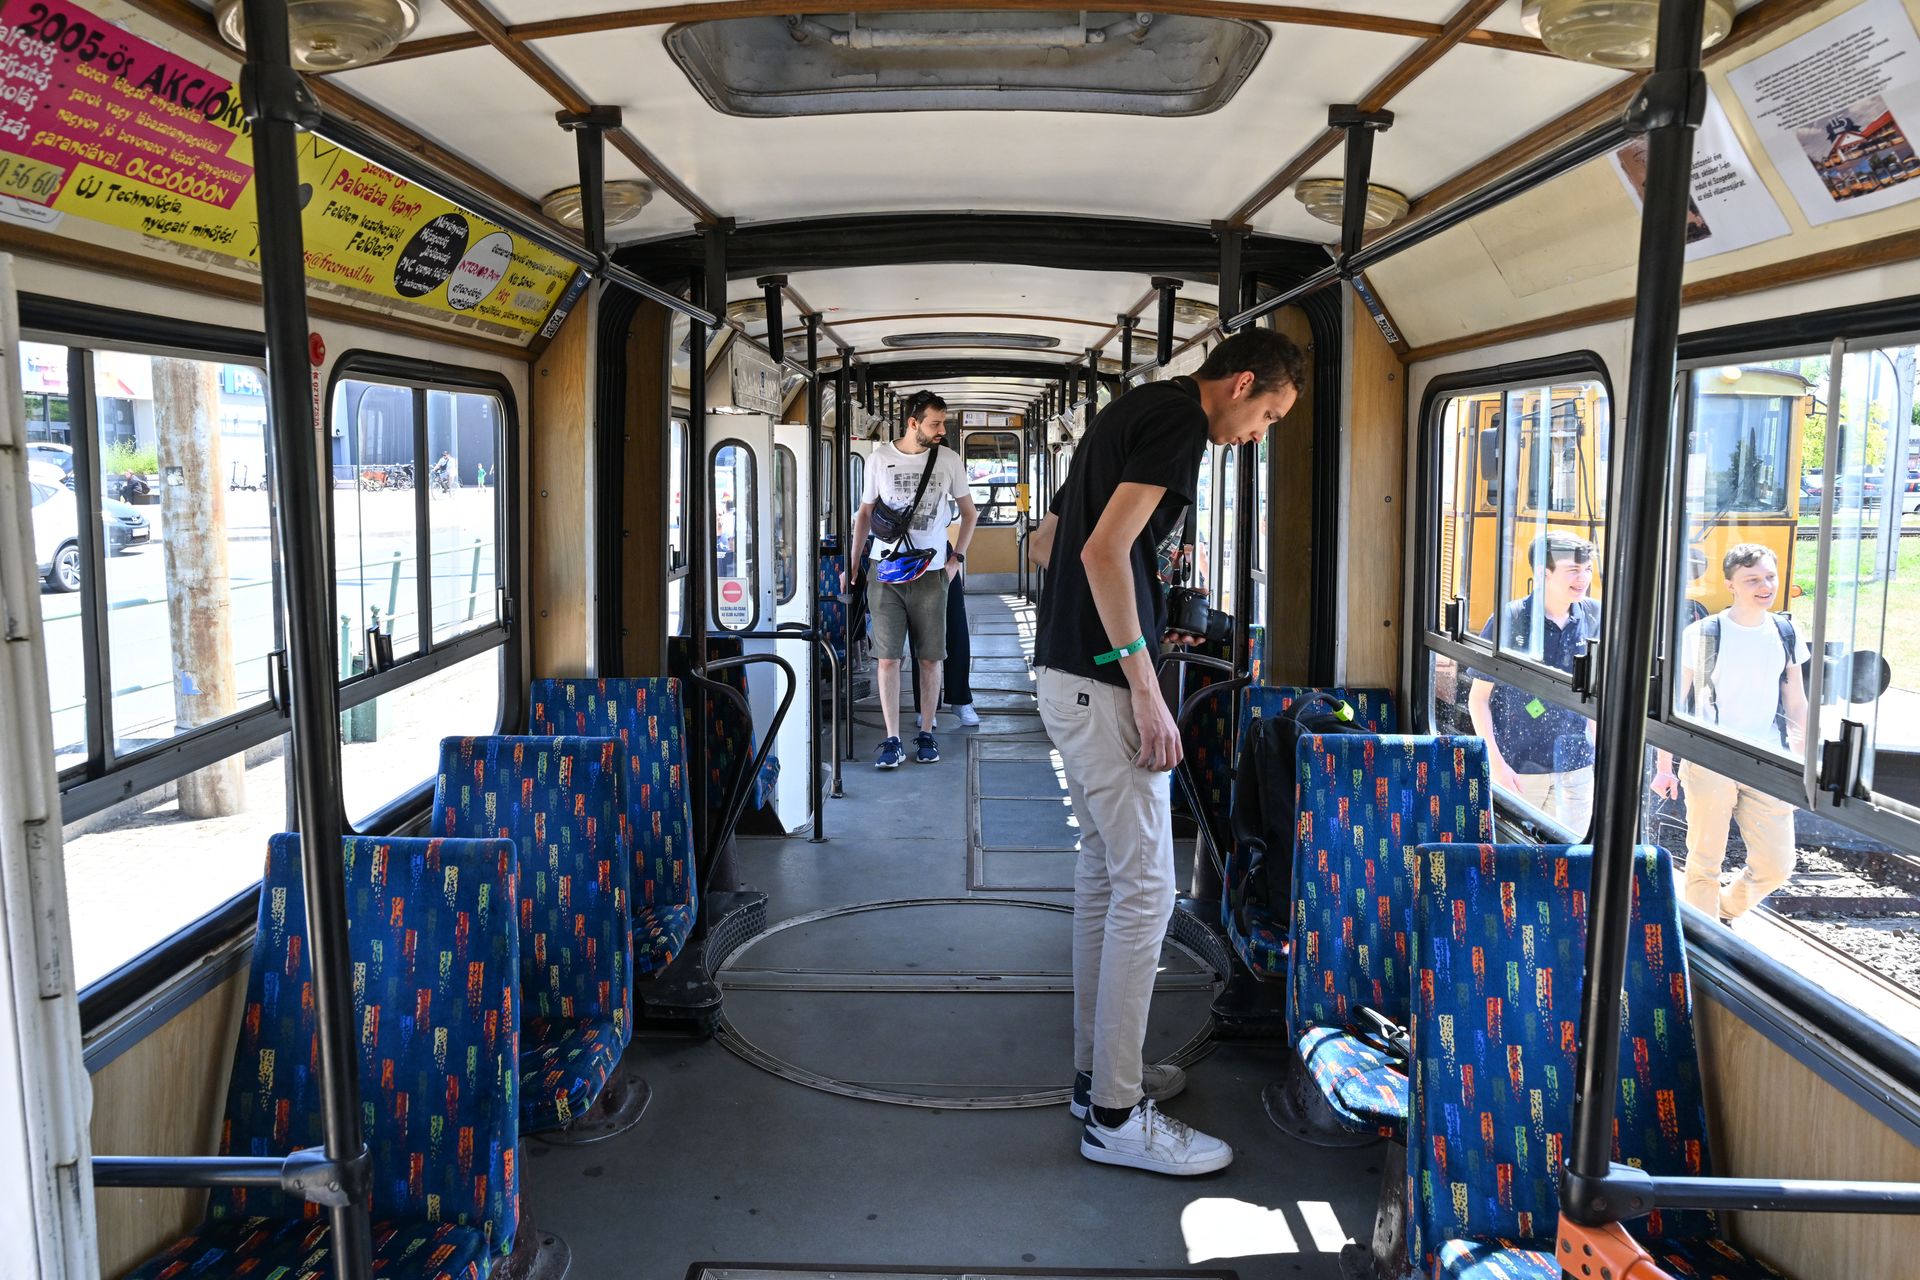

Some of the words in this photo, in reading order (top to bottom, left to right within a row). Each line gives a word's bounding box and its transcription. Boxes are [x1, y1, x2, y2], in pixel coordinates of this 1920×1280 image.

[18, 3, 134, 79] 2005-ös
[56, 108, 99, 133] nagyon
[106, 101, 133, 122] vagy
[32, 130, 123, 171] garanciával,
[104, 184, 182, 216] Technológia,
[321, 200, 359, 226] Felőlem
[141, 216, 190, 243] nyugati
[190, 224, 238, 243] minőség!
[345, 231, 395, 261] Felőled?
